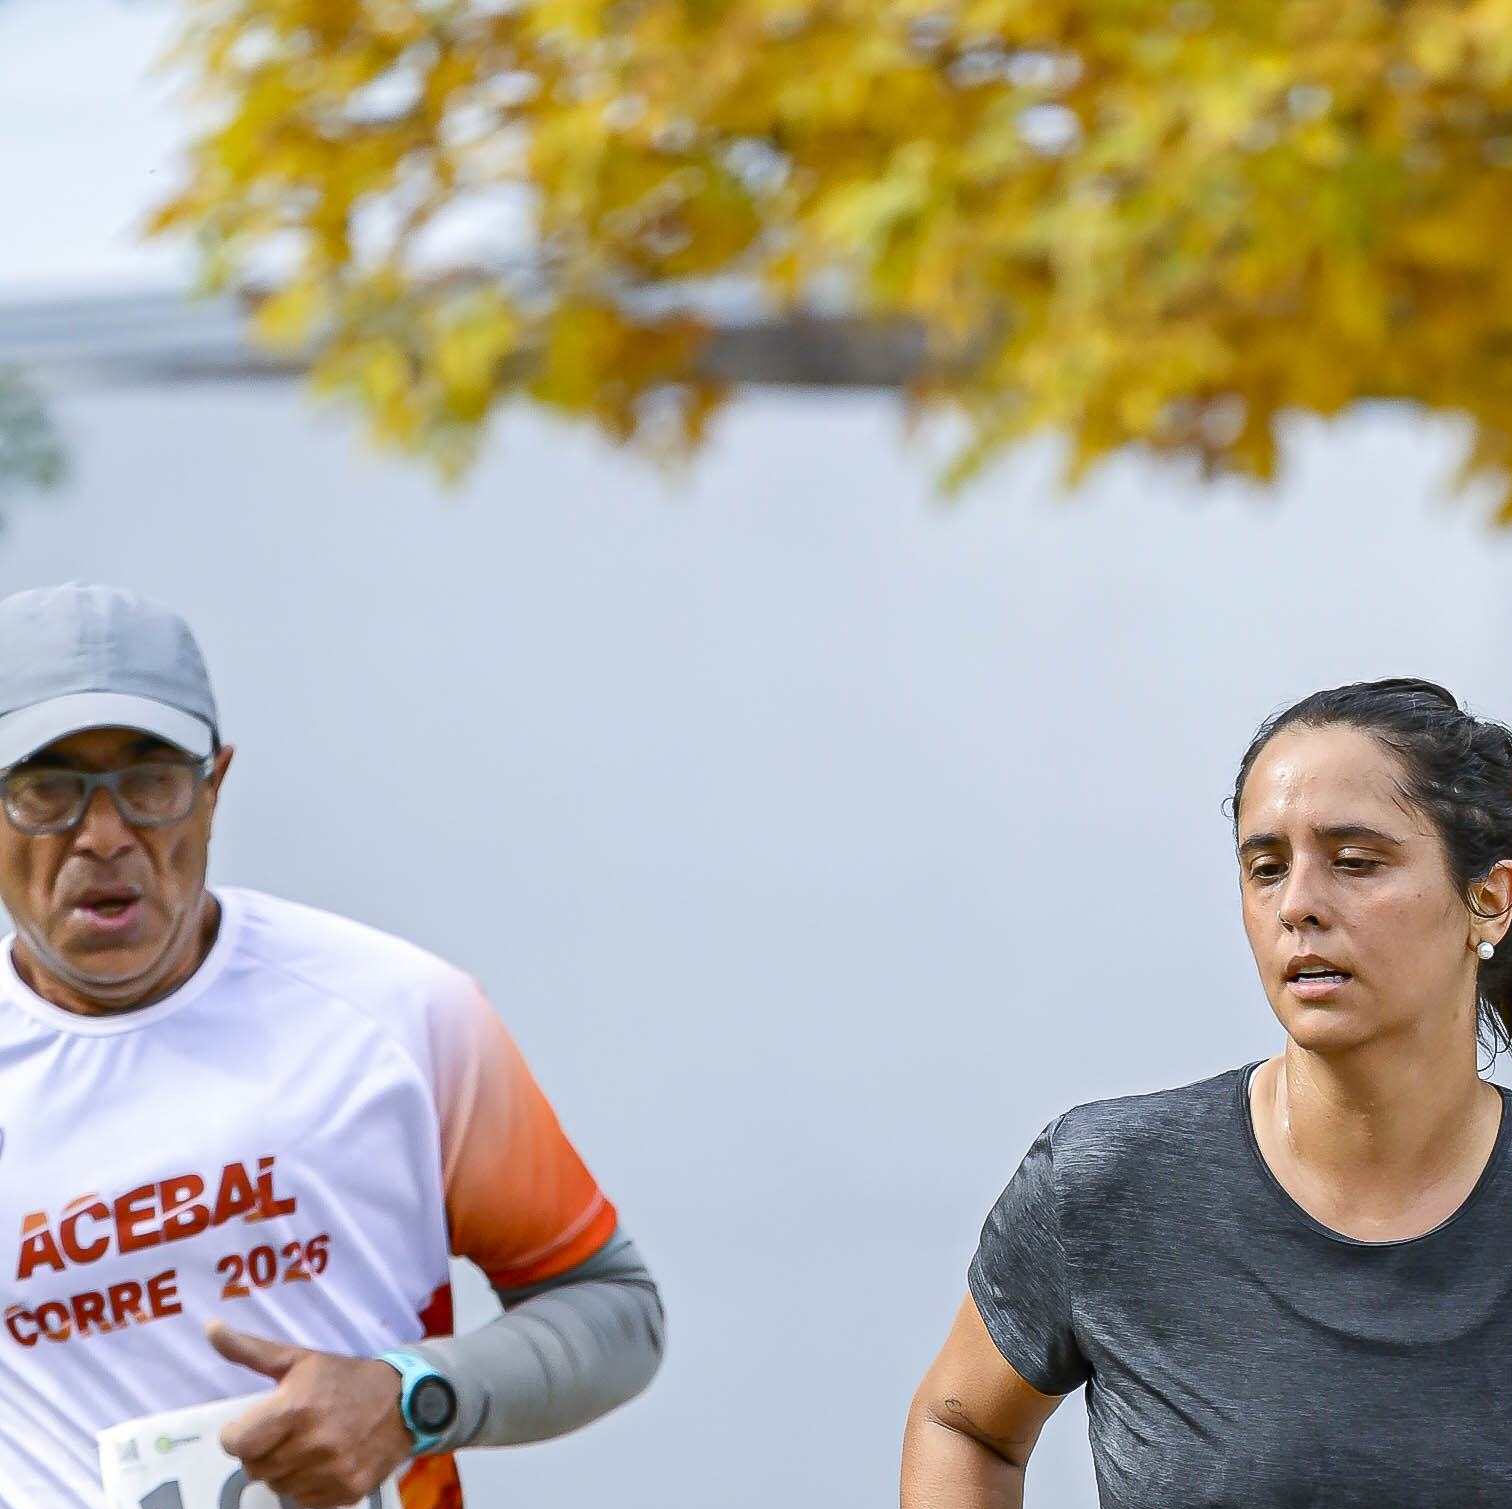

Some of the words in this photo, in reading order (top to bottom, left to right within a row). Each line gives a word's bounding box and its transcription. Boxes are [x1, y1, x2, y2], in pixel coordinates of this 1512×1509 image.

[16, 1156, 296, 1281] ACEBAL
[5, 1269, 183, 1346] CORRE
[216, 1234, 330, 1299] 2026
